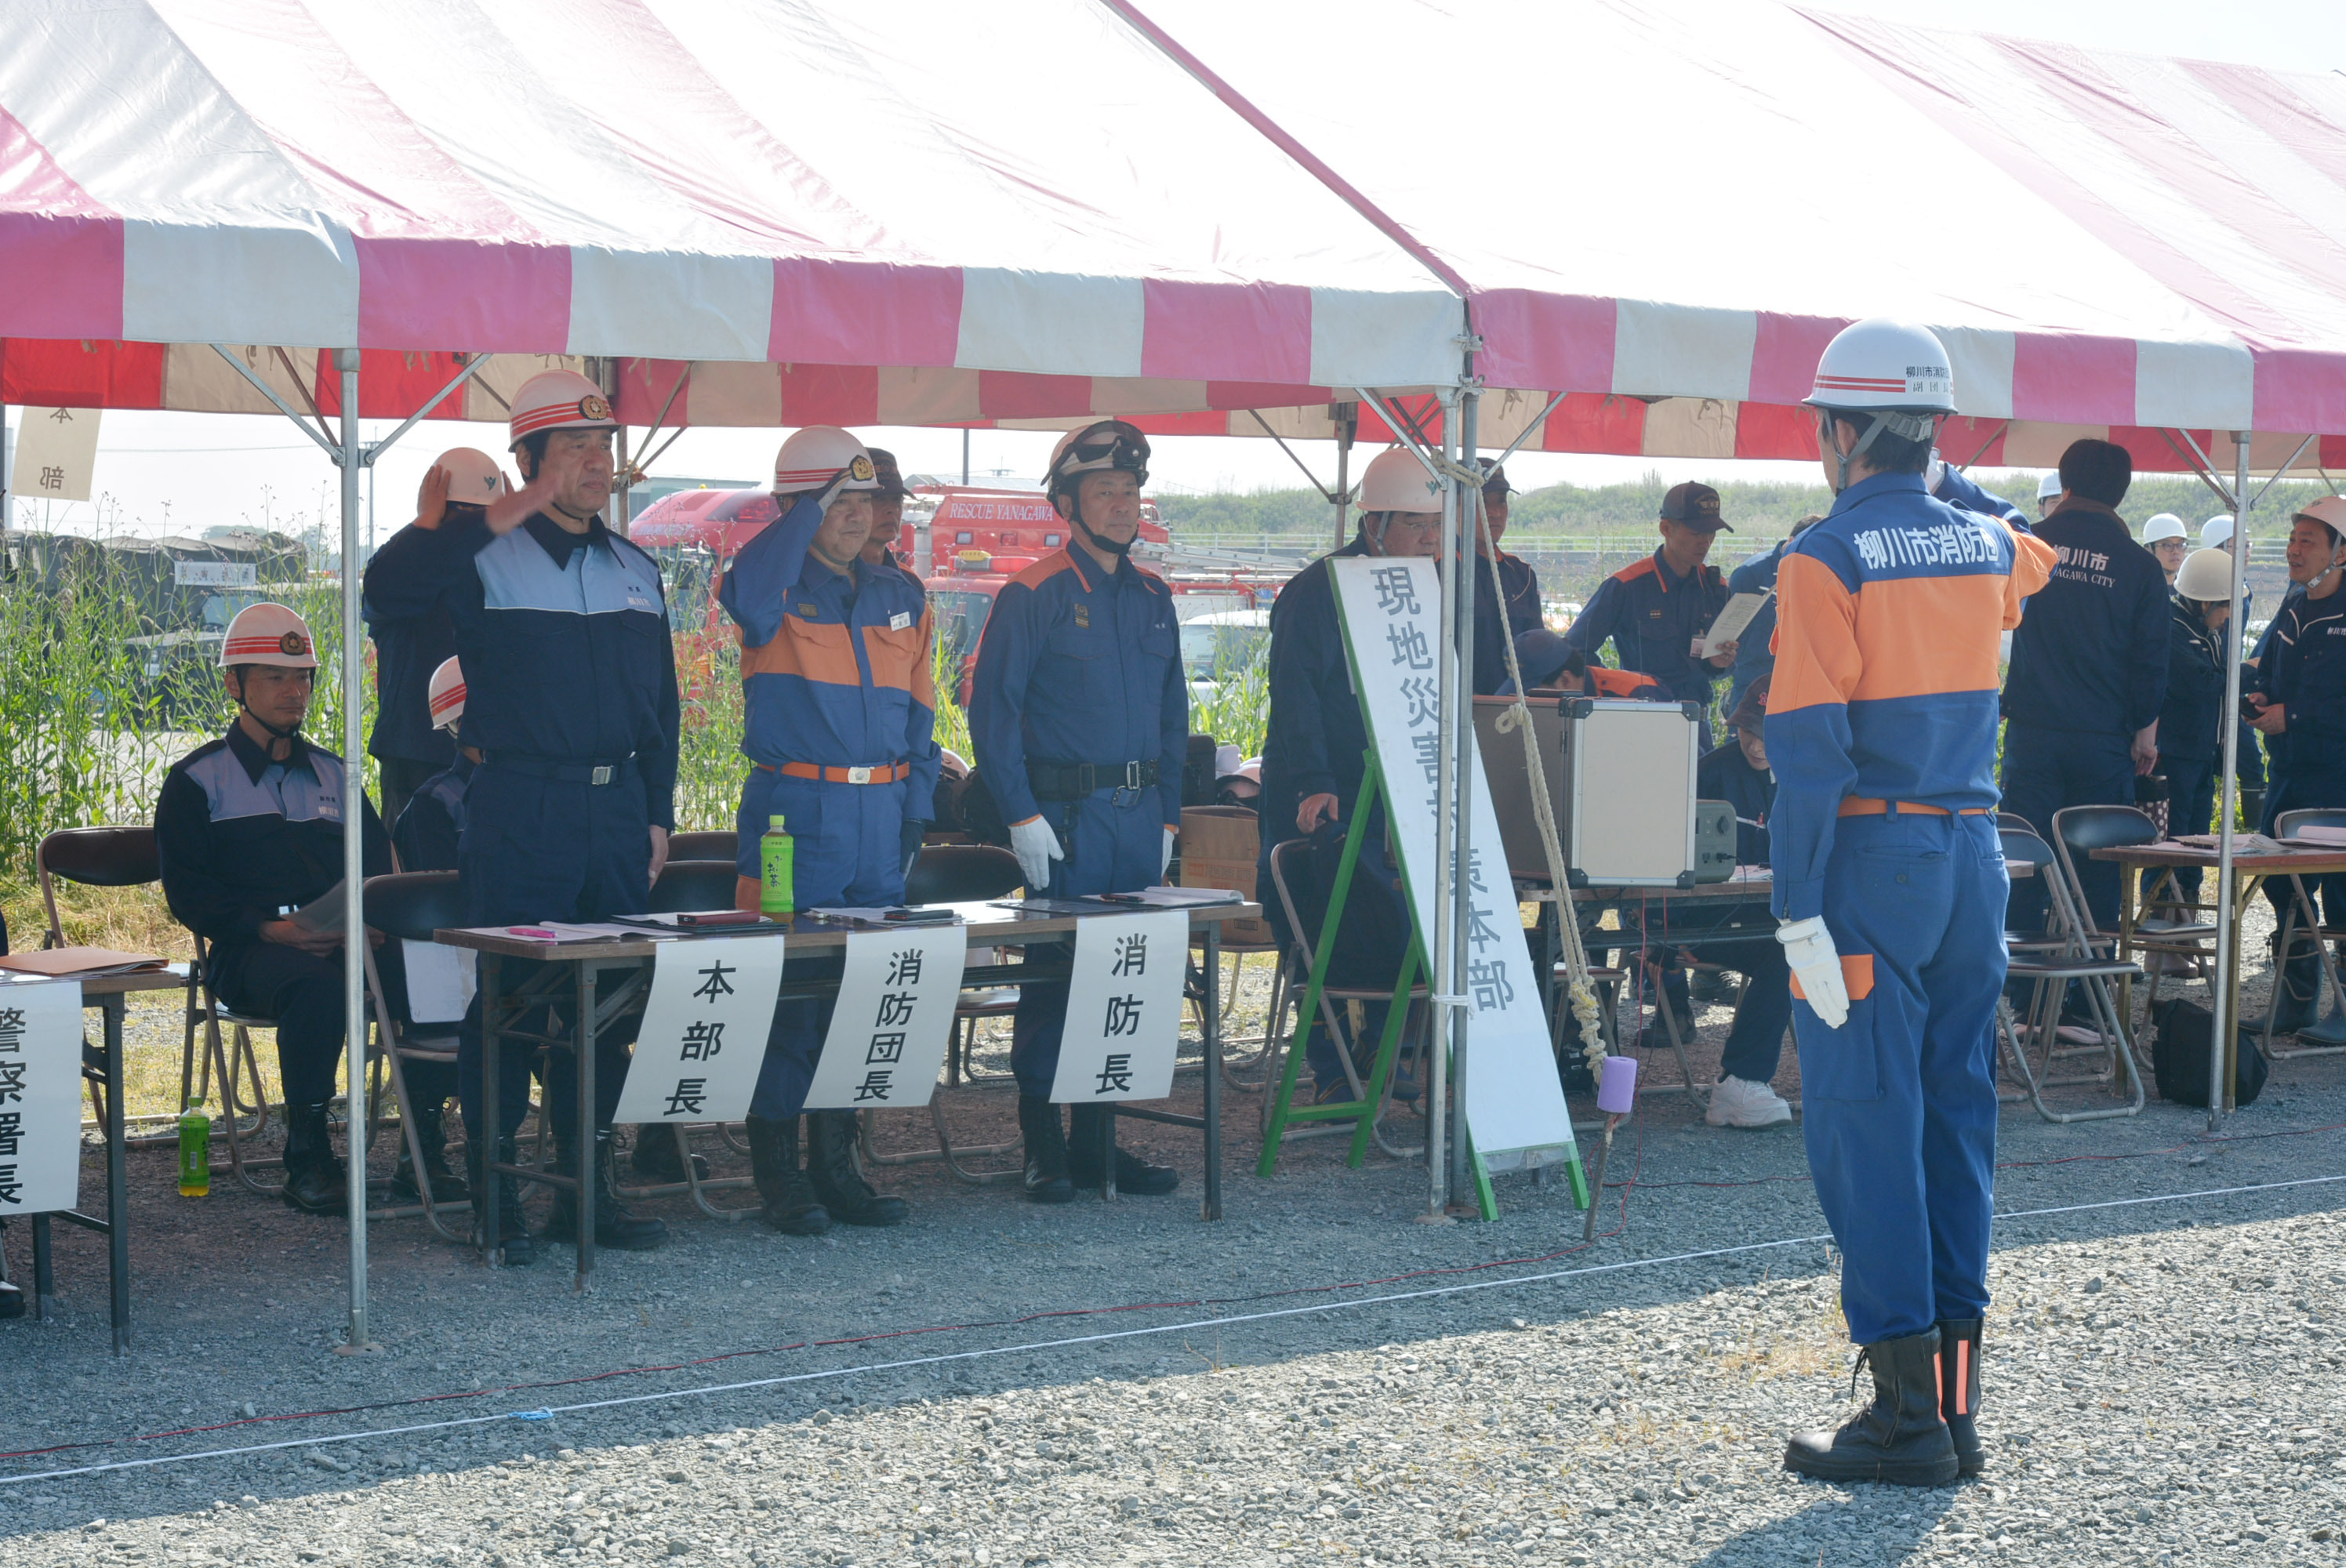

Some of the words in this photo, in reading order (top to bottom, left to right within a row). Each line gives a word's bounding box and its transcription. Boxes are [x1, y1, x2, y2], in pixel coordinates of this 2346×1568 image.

[950, 503, 993, 520] RESCUE
[997, 505, 1053, 521] YANAGAWA
[1854, 522, 1999, 570] 柳川市消防団
[2055, 567, 2087, 583] AGAWA
[2091, 574, 2116, 588] CITY
[663, 960, 736, 1116] 本部長
[853, 948, 923, 1102] 消防団長
[1095, 933, 1147, 1094] 消防長
